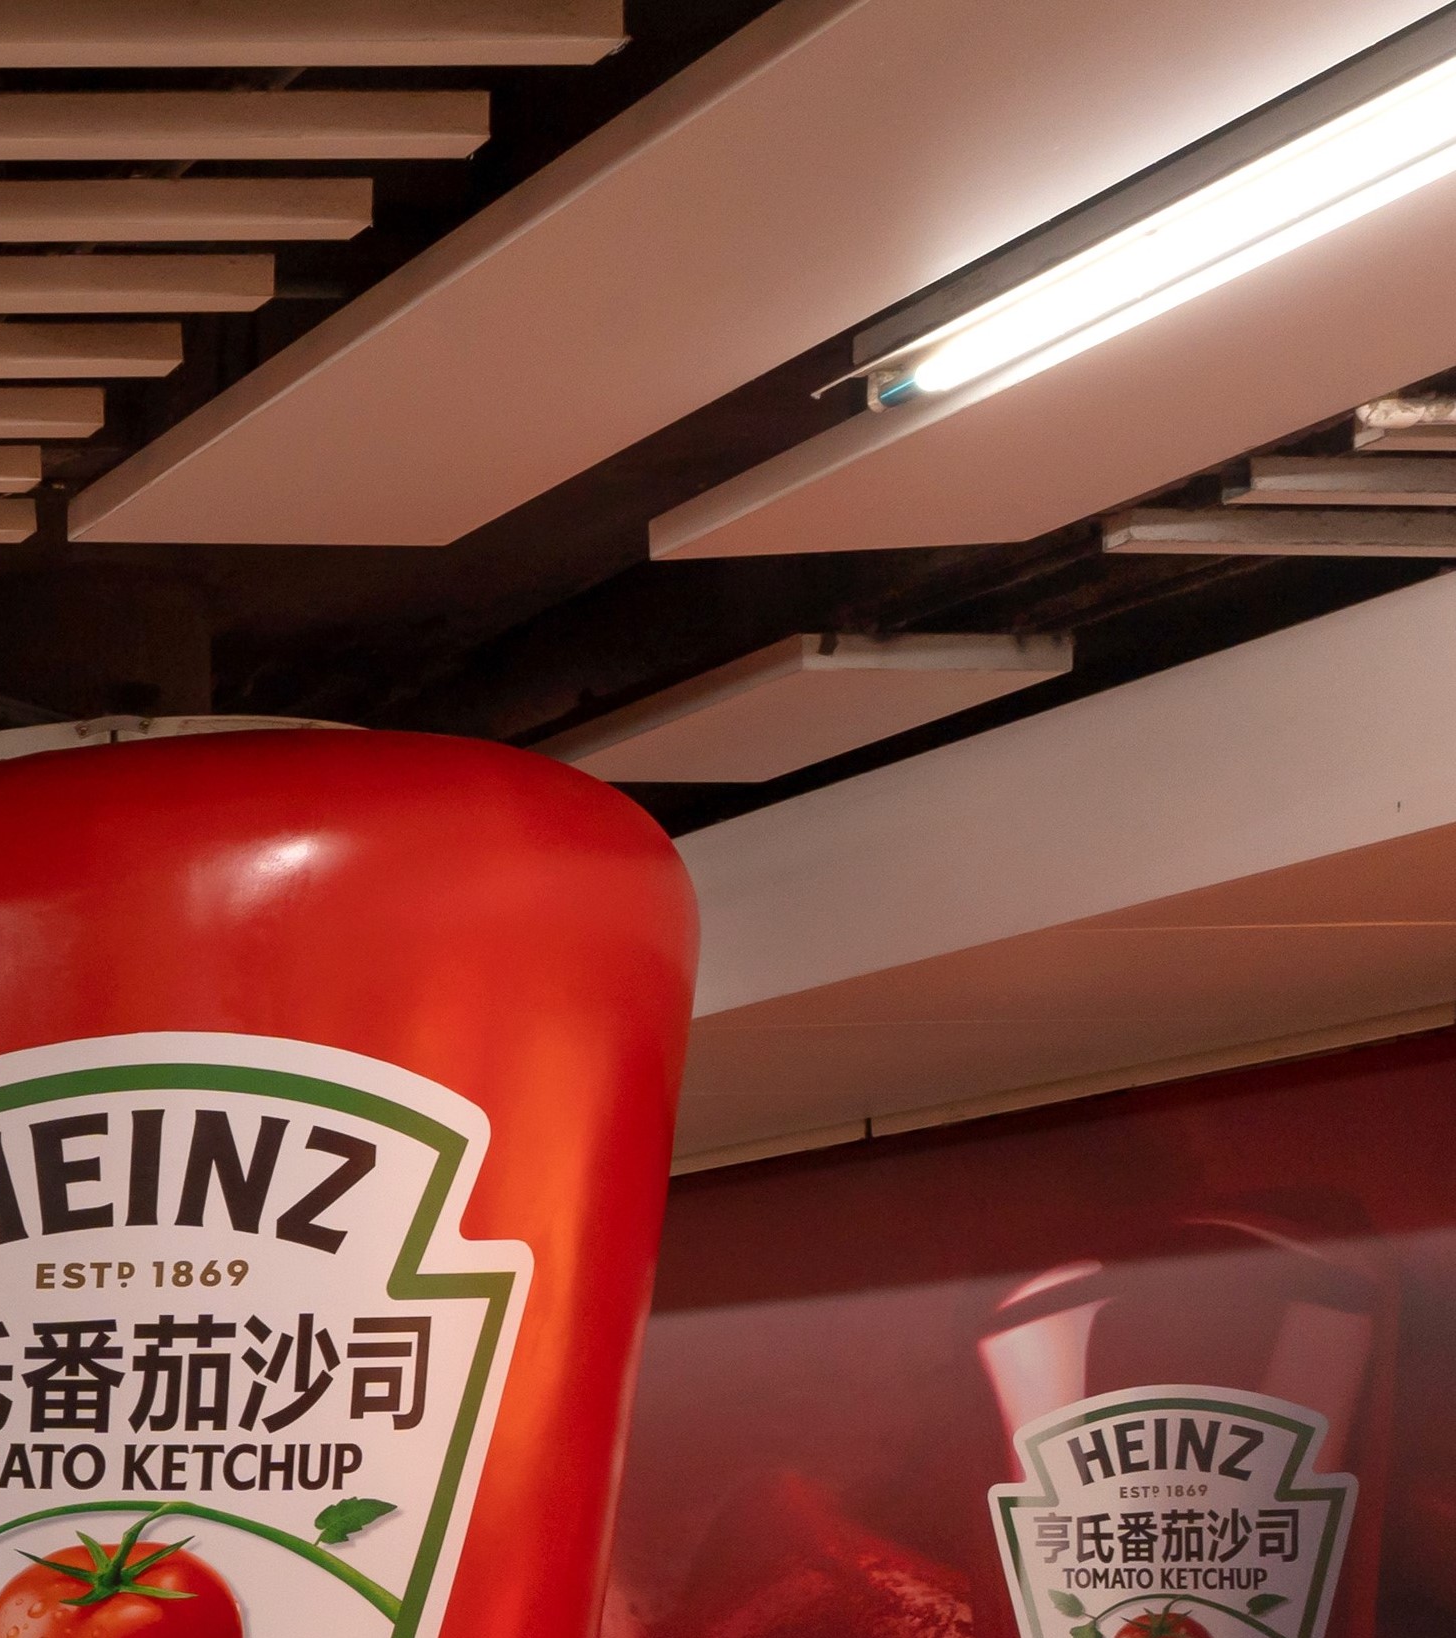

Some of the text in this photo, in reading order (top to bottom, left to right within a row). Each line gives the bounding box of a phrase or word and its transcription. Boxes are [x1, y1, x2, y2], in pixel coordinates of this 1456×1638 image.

[152, 1258, 250, 1288] 1869
[122, 1441, 363, 1493] KETCHUP
[1066, 1417, 1265, 1487] HEINZ
[1165, 1484, 1208, 1498] 1869
[1033, 1507, 1300, 1564] 亨氏番茄沙司
[1061, 1567, 1269, 1590] TOMATO KETCHUP
